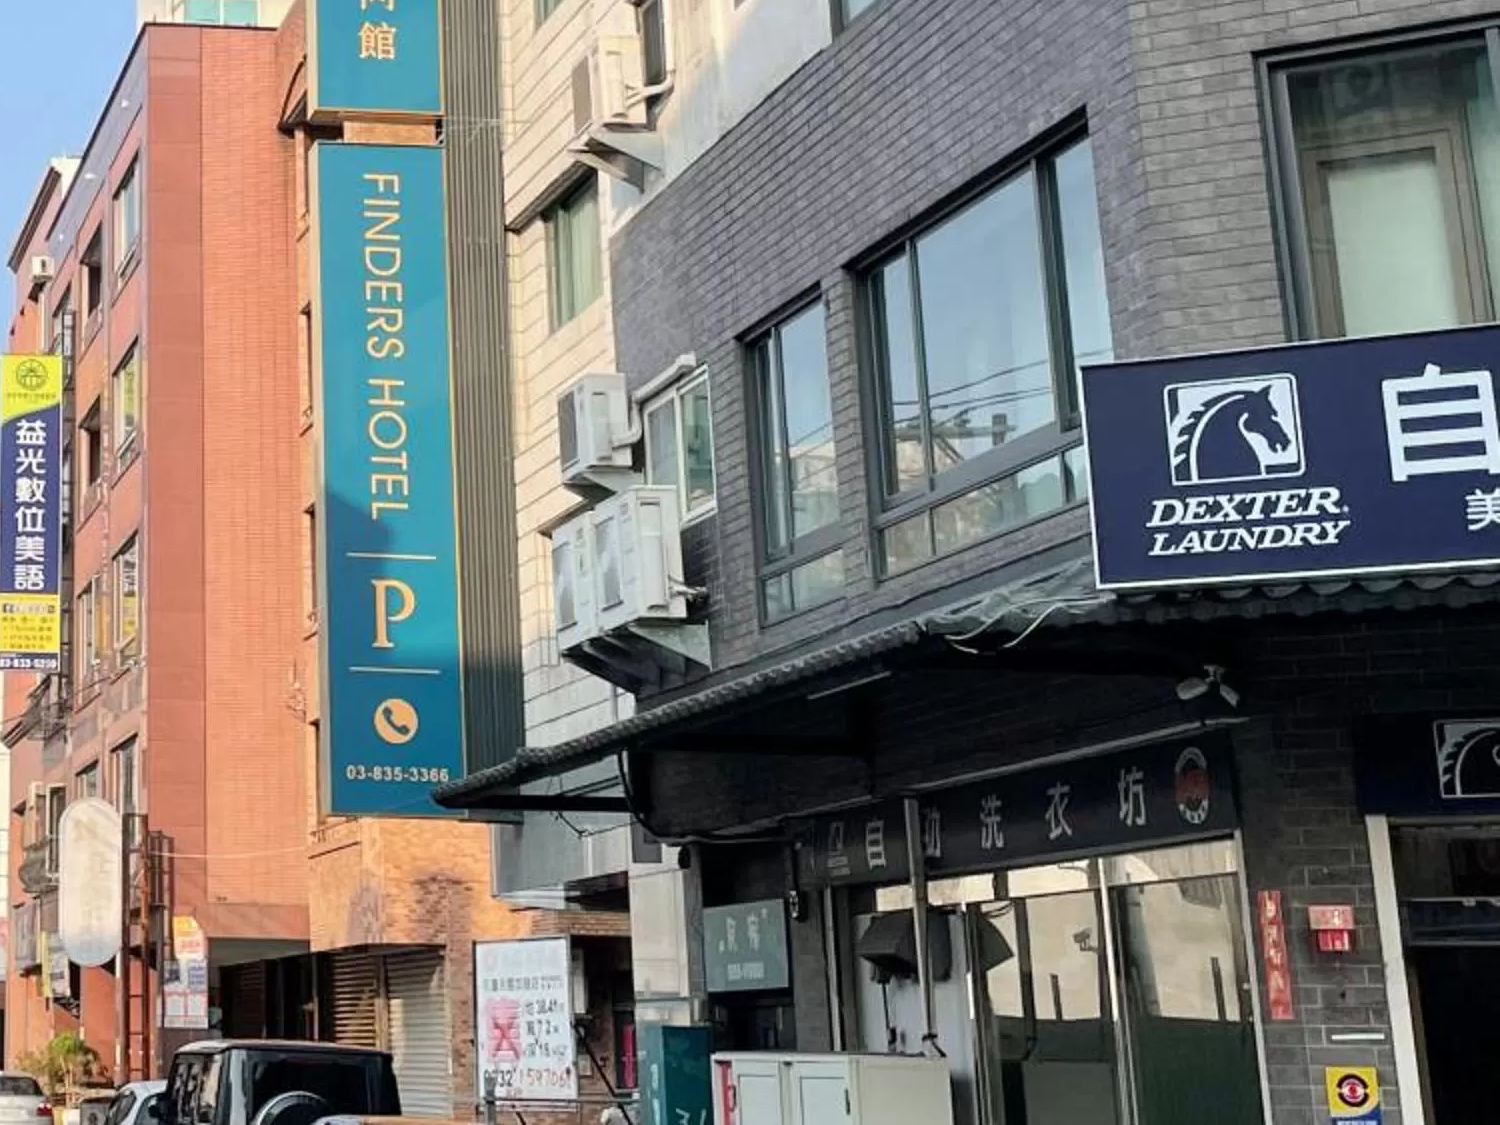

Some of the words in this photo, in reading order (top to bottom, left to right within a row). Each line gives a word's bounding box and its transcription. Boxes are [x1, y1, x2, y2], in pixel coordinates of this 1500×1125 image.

[363, 172, 405, 360] FINDERS
[368, 379, 409, 521] HOTEL
[14, 418, 47, 591] 益光數位美語
[1146, 487, 1343, 528] DEXTER
[1148, 519, 1351, 556] LAUNDRY
[370, 578, 416, 650] P
[345, 763, 450, 783] 03-835-3366
